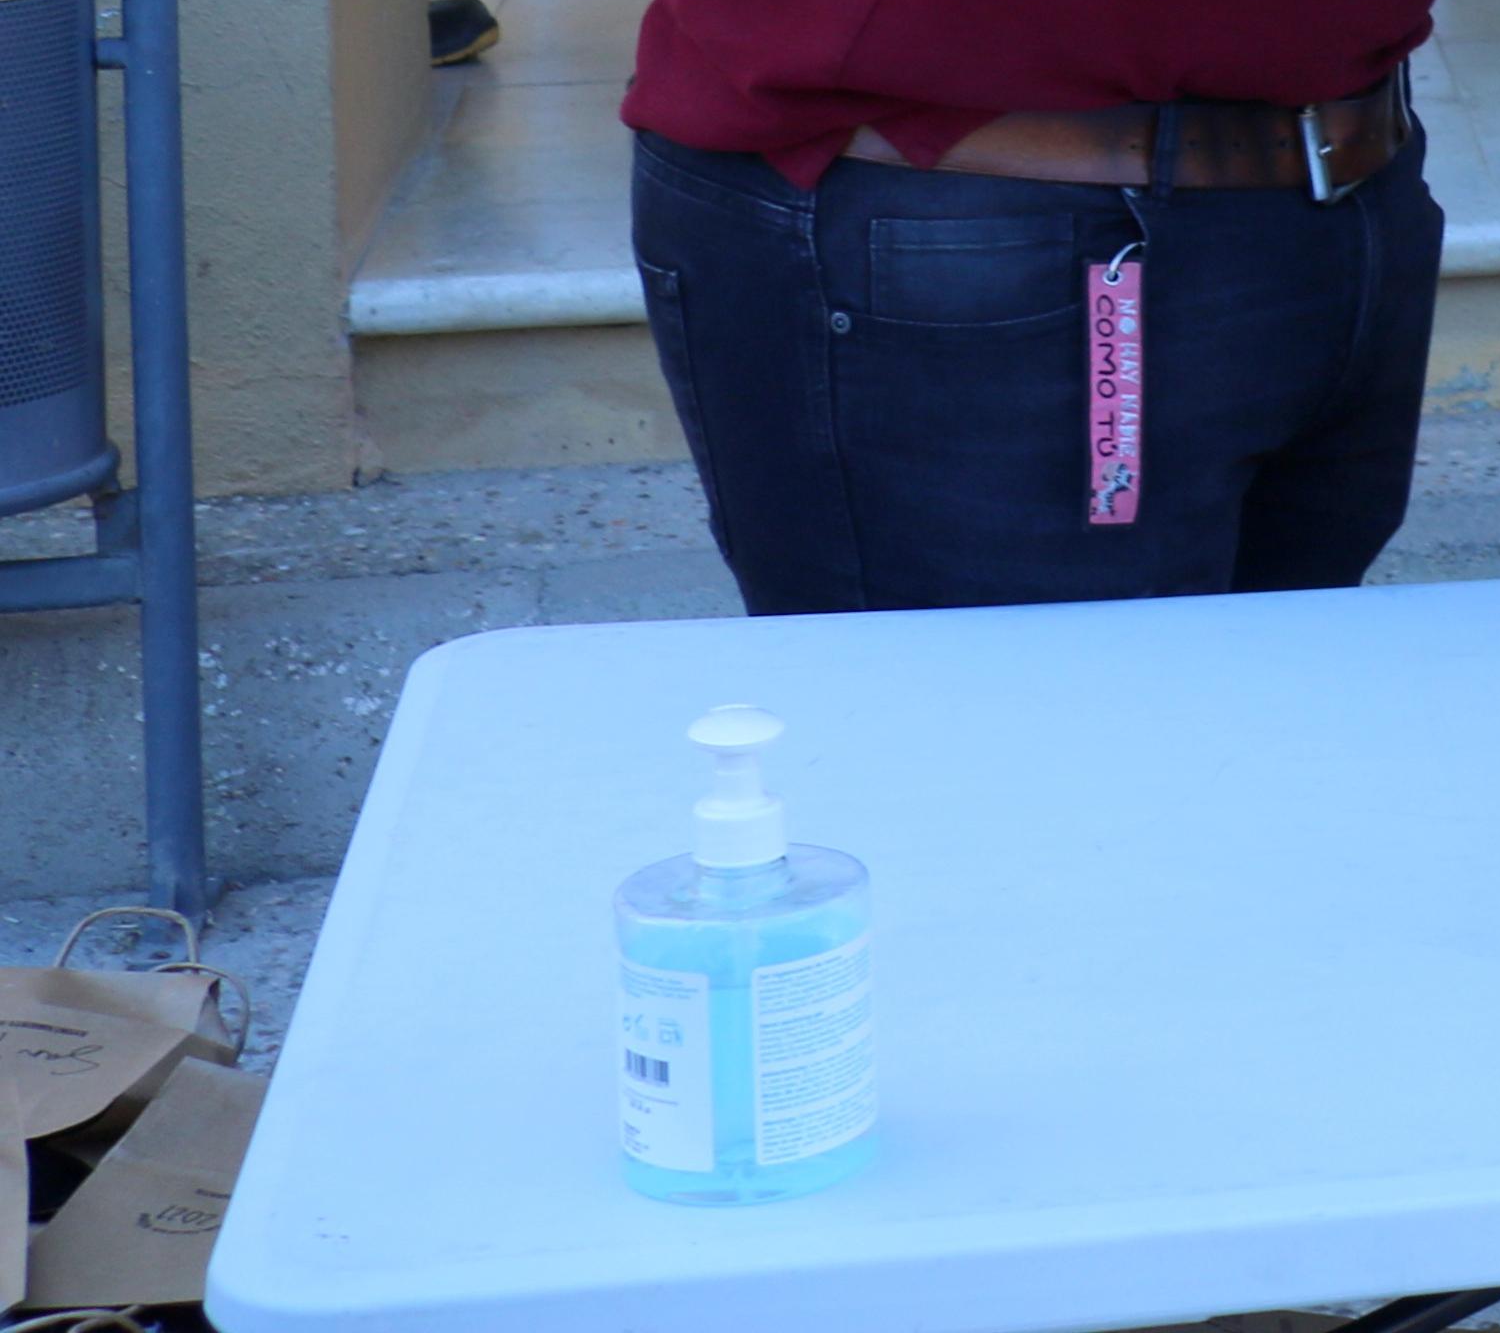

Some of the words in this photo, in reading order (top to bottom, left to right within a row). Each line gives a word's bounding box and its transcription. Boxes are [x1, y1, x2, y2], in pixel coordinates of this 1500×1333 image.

[1118, 297, 1138, 335] NO
[1095, 294, 1117, 400] COMO
[1118, 342, 1141, 386] HAY
